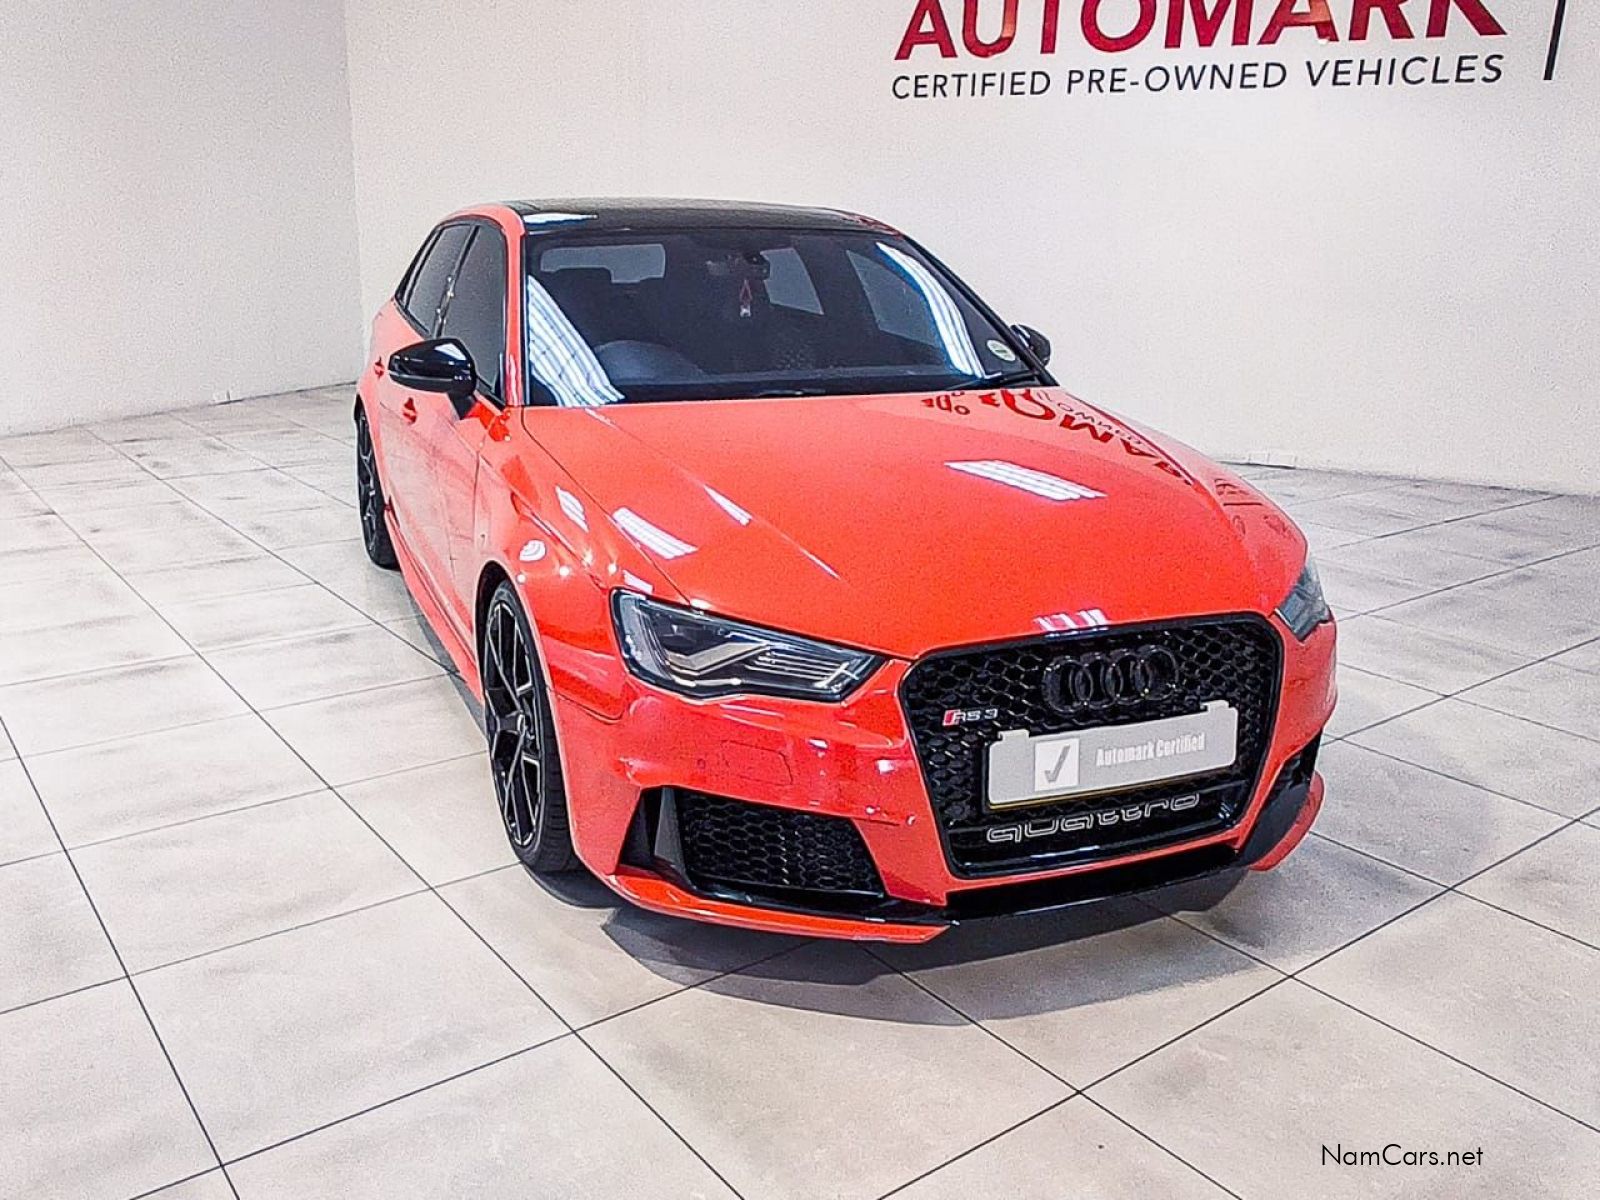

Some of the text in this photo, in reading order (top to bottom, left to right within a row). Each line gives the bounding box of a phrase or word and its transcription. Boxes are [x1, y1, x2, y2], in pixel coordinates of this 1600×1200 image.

[892, 54, 1504, 99] CERTIFIED PRE-OWNED VEHICLES
[1096, 732, 1205, 766] Automark Certified
[986, 792, 1200, 843] quattro
